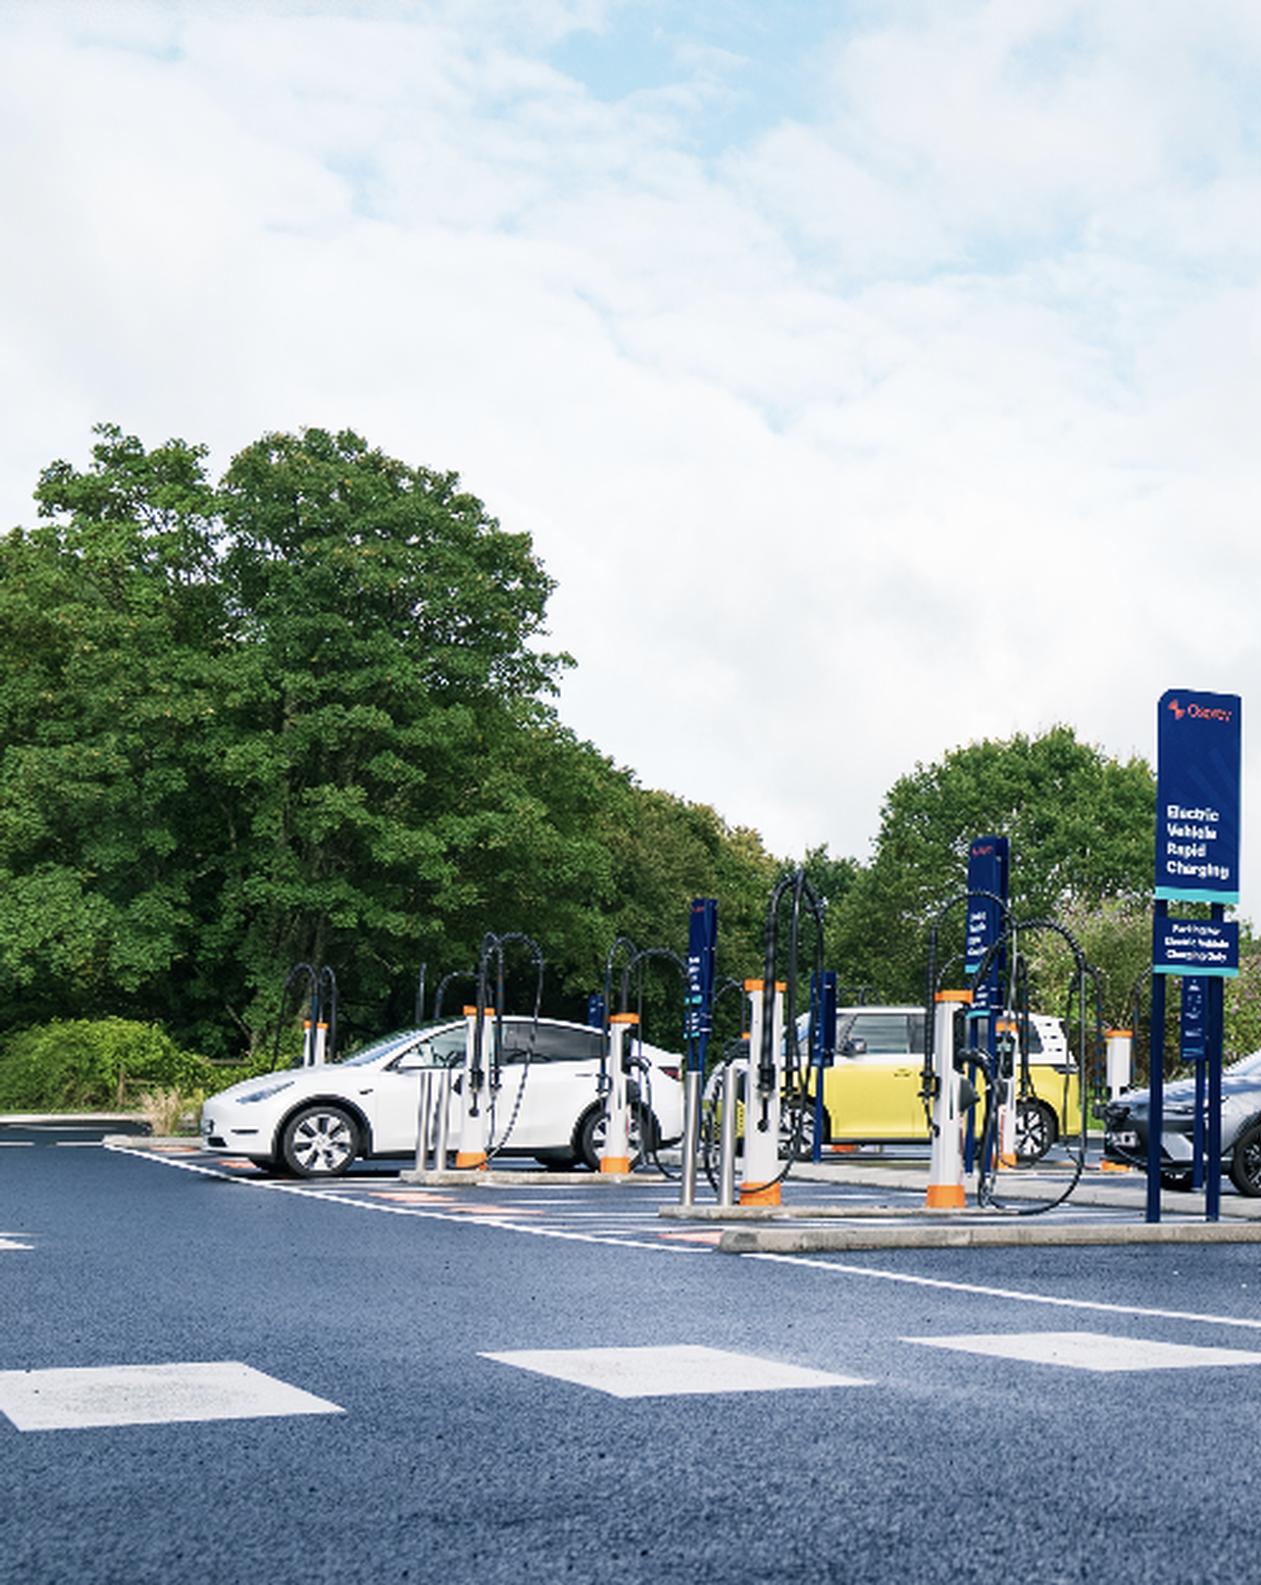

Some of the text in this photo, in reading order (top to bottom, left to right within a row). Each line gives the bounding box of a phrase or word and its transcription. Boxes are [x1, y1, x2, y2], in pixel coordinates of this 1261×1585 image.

[1167, 804, 1219, 821] Electric
[1167, 823, 1216, 839] Vehicle
[1167, 842, 1207, 859] Rapid
[1166, 860, 1230, 880] Charging
